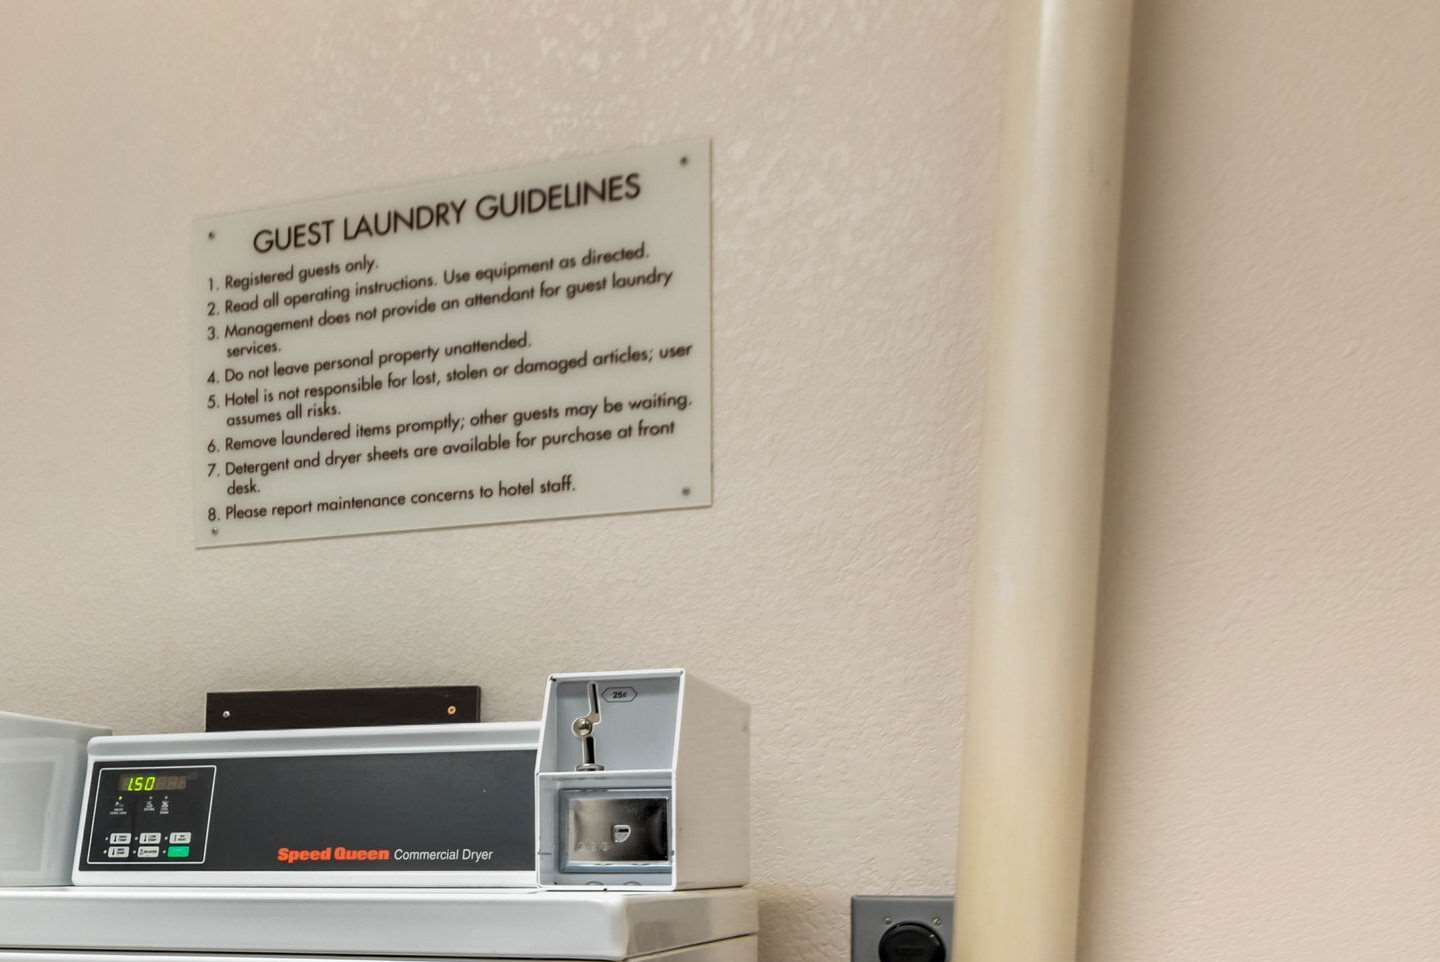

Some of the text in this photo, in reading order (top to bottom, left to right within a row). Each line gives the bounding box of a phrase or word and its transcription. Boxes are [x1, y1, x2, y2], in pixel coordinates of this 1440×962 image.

[252, 172, 642, 255] GUEST LAUNDRY GUIDELINES
[207, 240, 649, 317] 2. Read all operating instructions. Use equipment as directed.
[208, 253, 379, 292] 1. Registered guests only.
[207, 265, 674, 342] 3. Management does not provide an attendant for guest laundry
[206, 330, 532, 385] 4. Do not leave personal property unattended.
[207, 344, 693, 410] 5. Hotel is not responsible for lost, stolen or damaged articles; user
[226, 341, 281, 359] services.
[206, 391, 692, 454] 6. Remove laundered items promptly; other guests may be waiting.
[225, 402, 342, 428] assumes all risks.
[207, 418, 676, 478] 7. Detergent and dryer sheets are available for purchase at front
[207, 473, 576, 523] 8. Please report maintenance concerns to hotel staff.
[226, 477, 261, 496] desk.
[277, 847, 494, 863] Speed Queen Commercial Dryer
